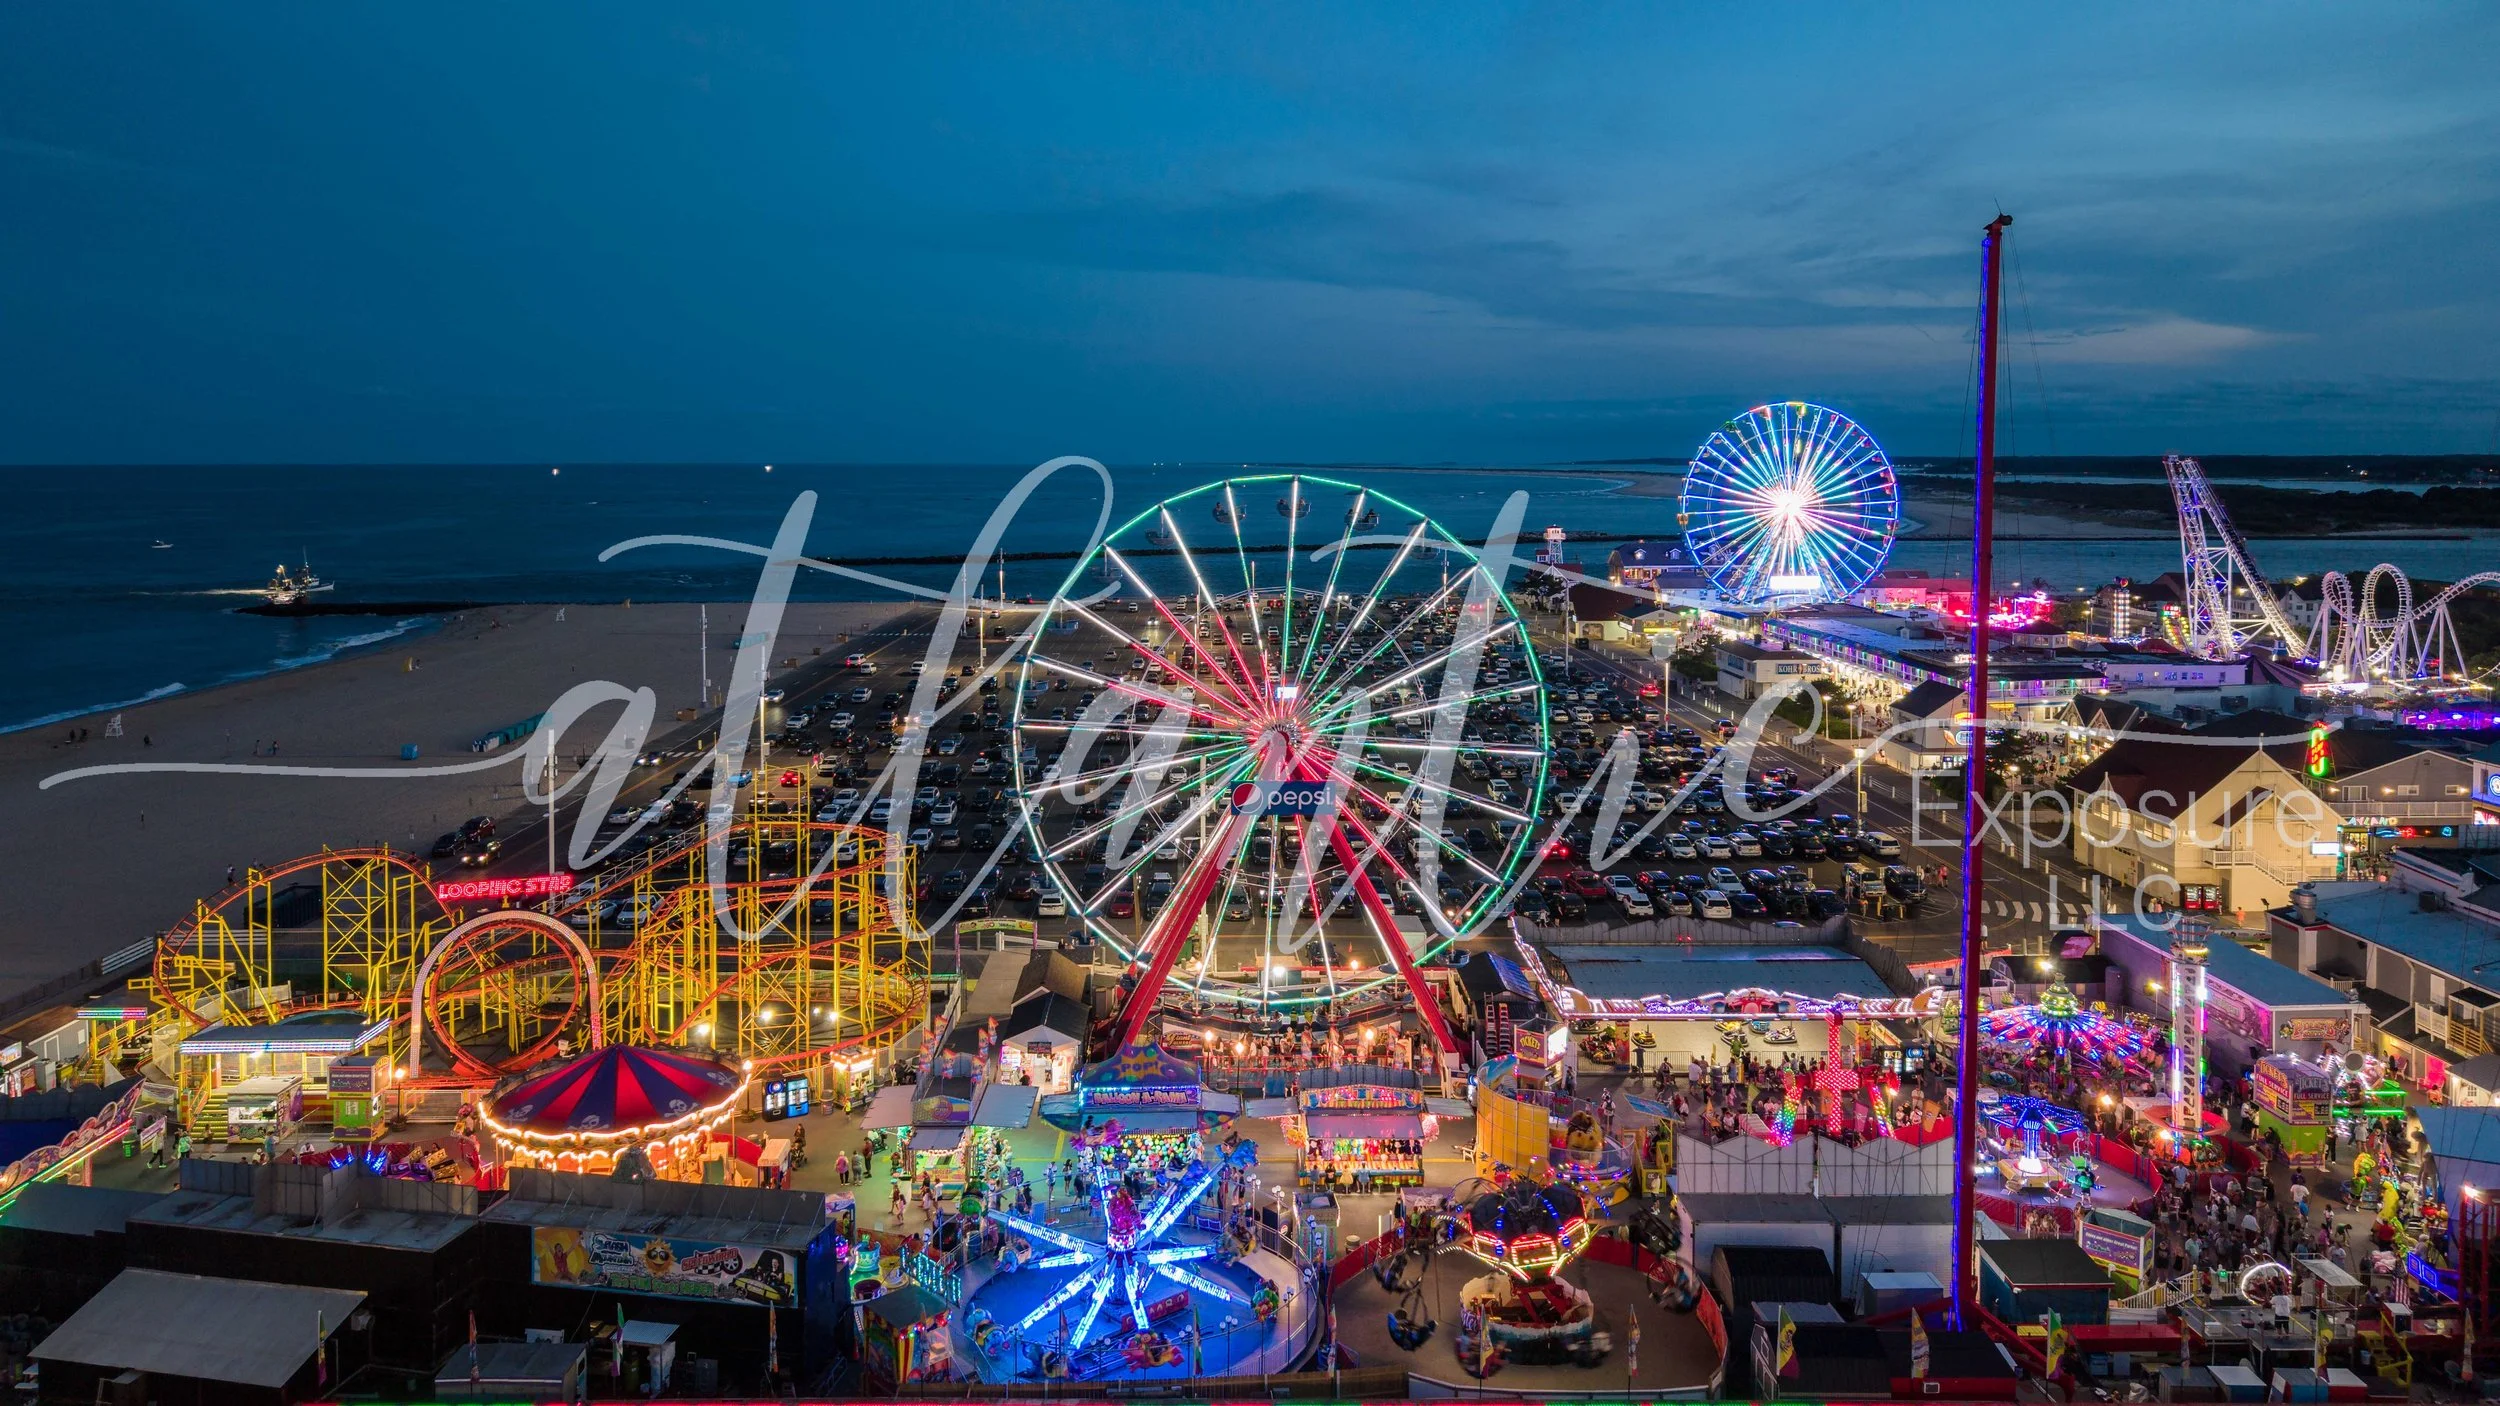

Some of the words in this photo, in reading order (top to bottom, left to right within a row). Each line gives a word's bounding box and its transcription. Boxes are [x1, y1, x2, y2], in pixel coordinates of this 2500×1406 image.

[1778, 665, 1798, 673] KOHR
[1268, 787, 1333, 810] pepsi
[439, 879, 521, 899] LOOPING
[525, 875, 572, 894] STAR
[1520, 1035, 1540, 1049] TICKETS
[1121, 1061, 1159, 1073] POP!
[2257, 1059, 2288, 1089] TICKETS
[2256, 1074, 2268, 1086] FULL
[2269, 1080, 2288, 1096] SERVICE
[2298, 1077, 2330, 1092] TICKETS
[2294, 1092, 2307, 1100] FULL
[2308, 1092, 2330, 1100] SERVICE
